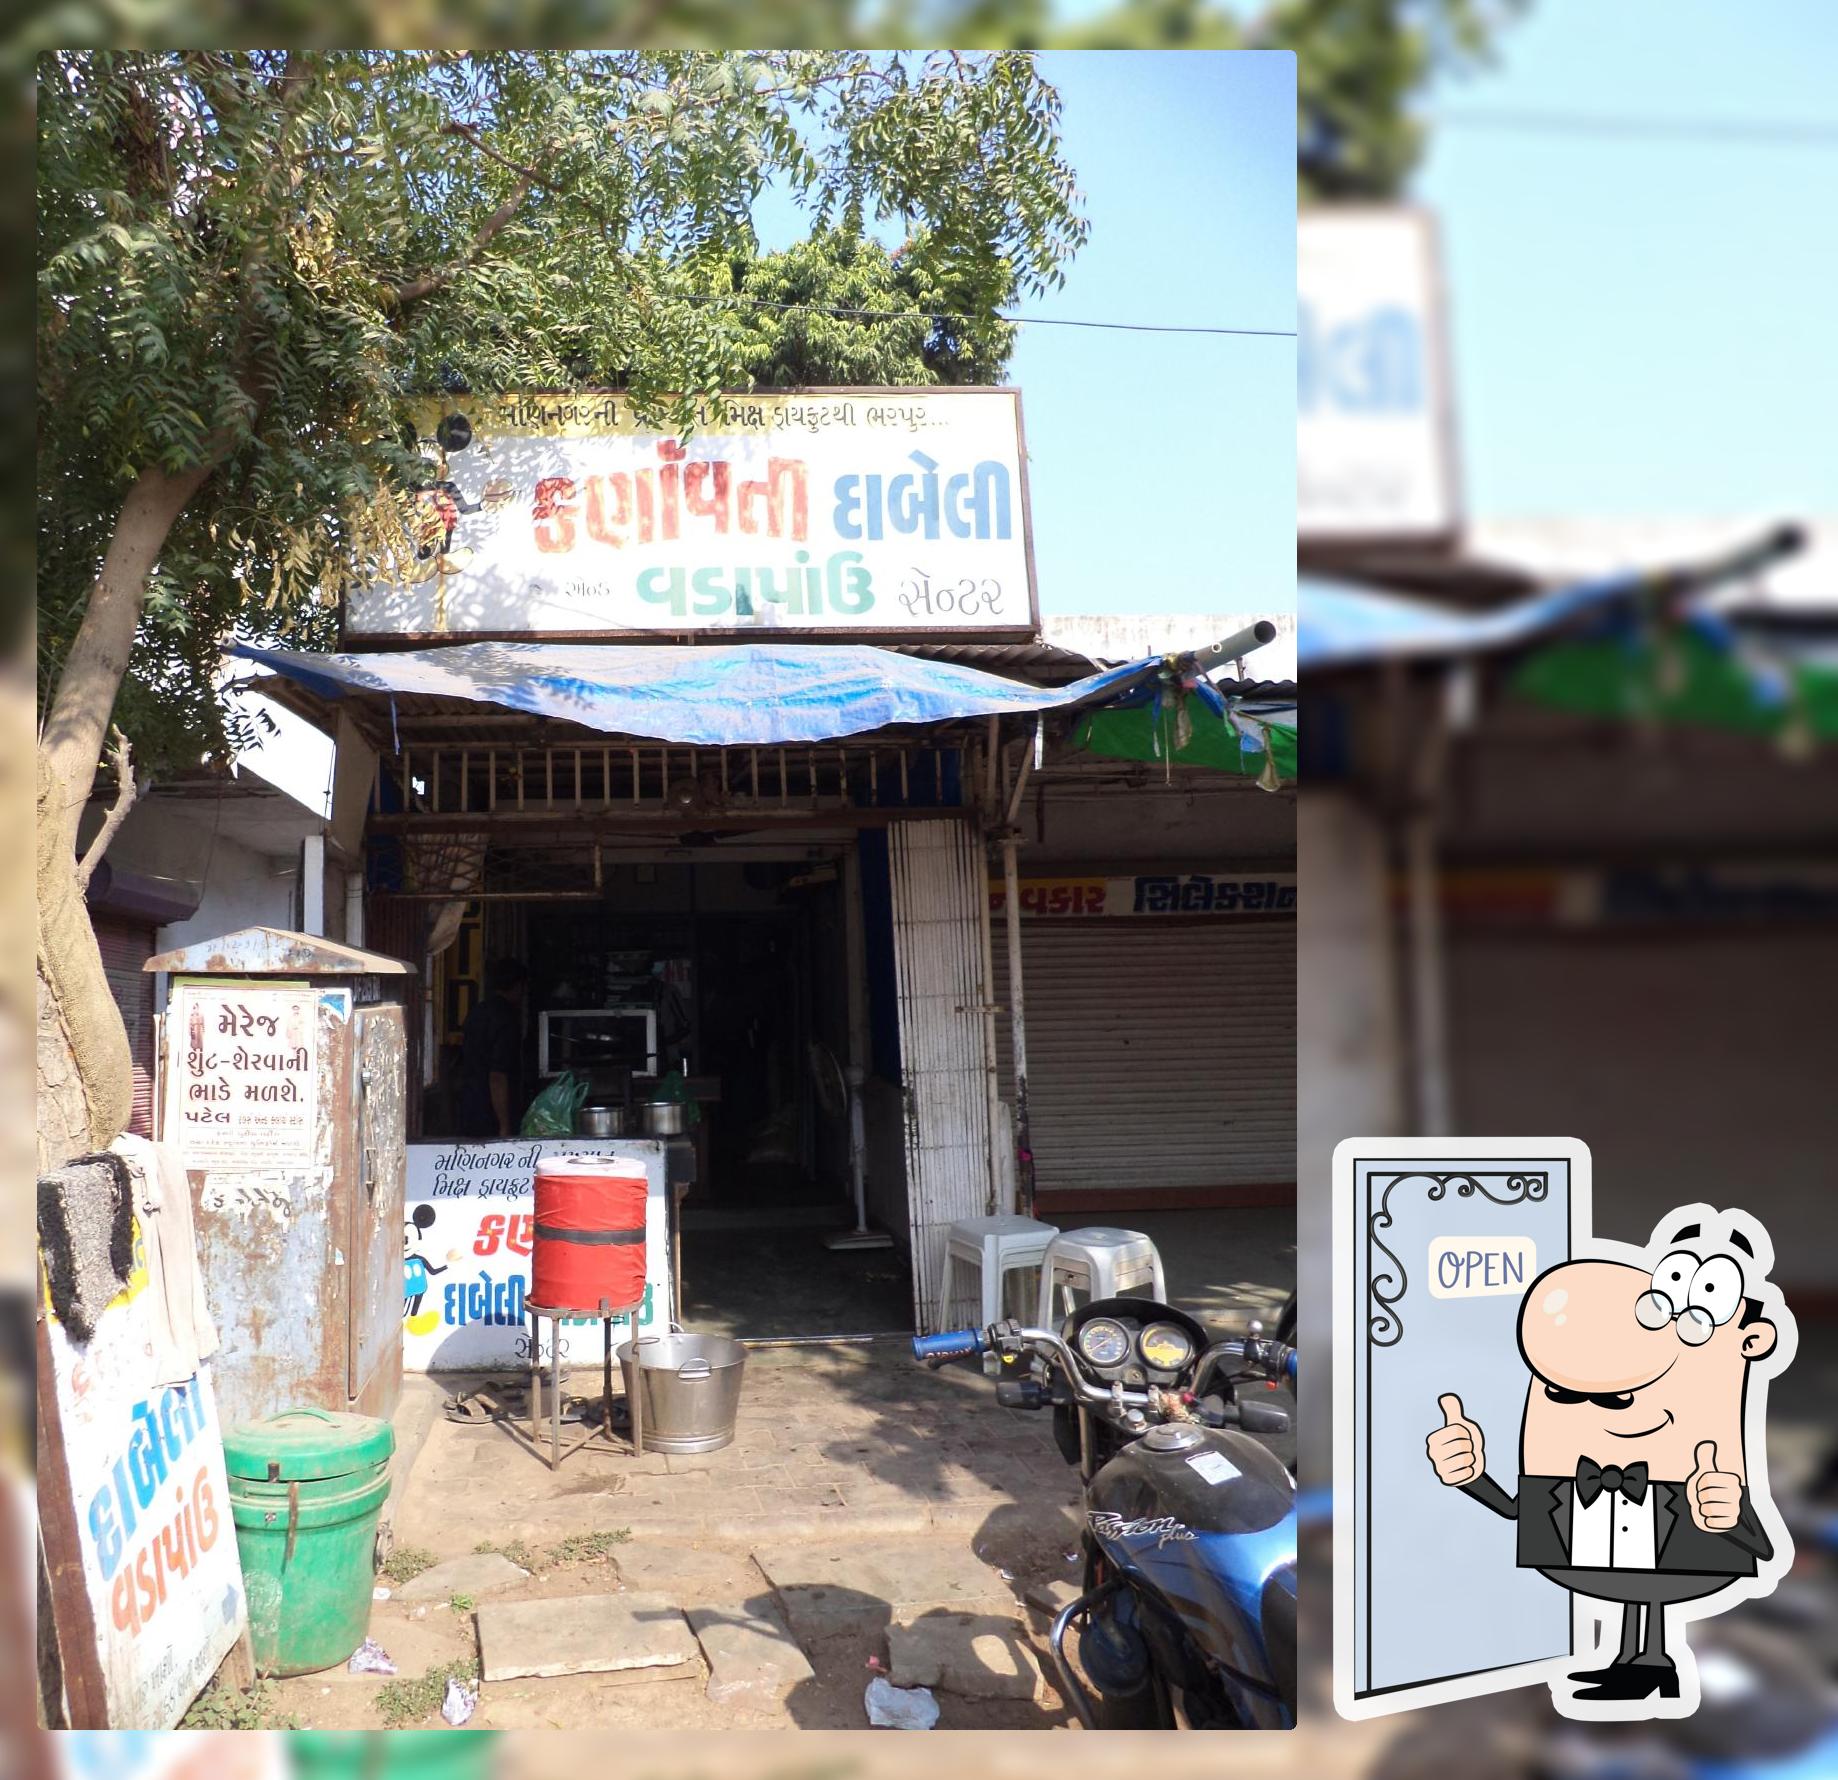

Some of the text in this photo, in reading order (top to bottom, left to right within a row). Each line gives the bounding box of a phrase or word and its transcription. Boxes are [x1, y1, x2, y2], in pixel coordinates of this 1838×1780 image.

[832, 448, 1012, 541] દાબેલી
[898, 566, 1004, 617] સેન્ટર
[217, 1003, 280, 1037] મેરેજ
[188, 1076, 305, 1103] ભાડે મળશે.
[184, 1106, 231, 1124] પટેલ
[443, 1269, 526, 1327] દાબેલી
